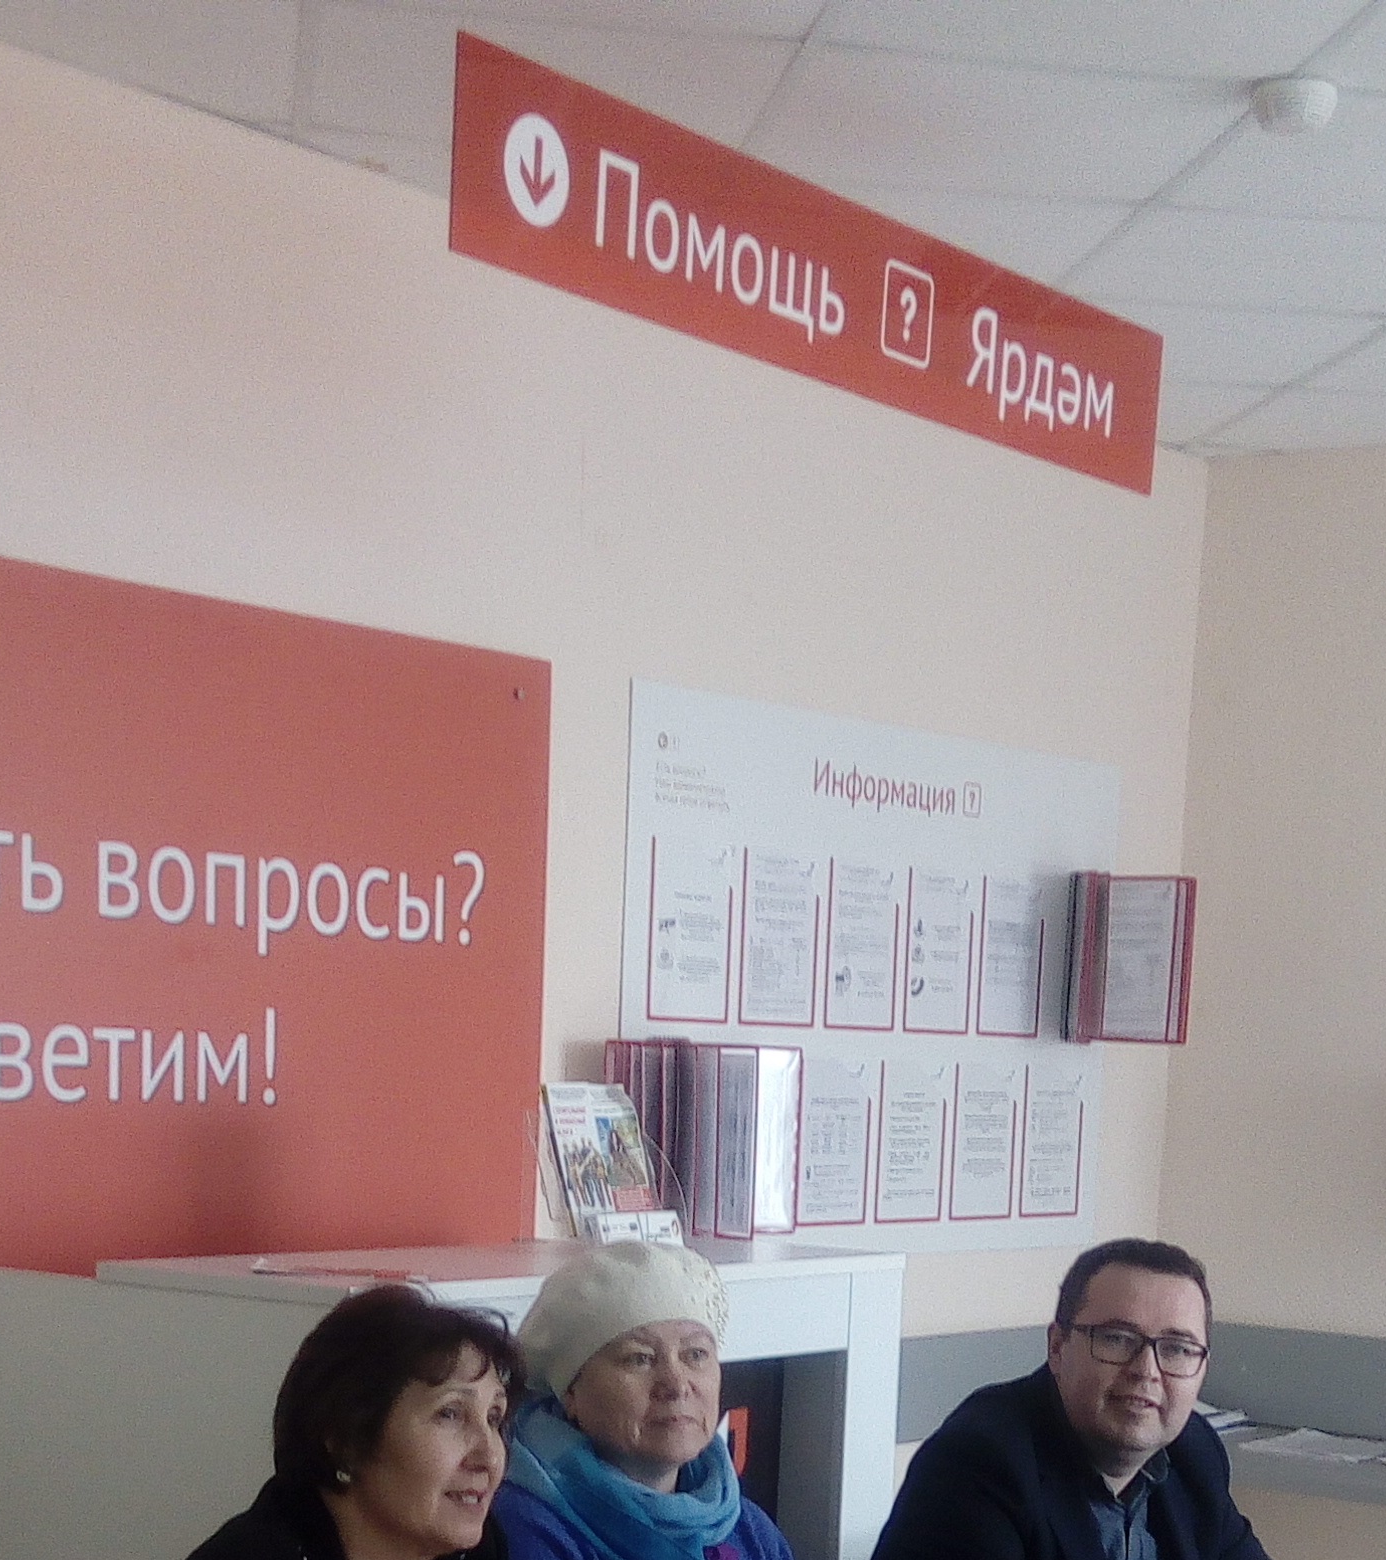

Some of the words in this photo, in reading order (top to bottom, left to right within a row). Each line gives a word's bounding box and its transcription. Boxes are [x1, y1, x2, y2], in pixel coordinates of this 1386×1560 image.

[594, 149, 844, 343] Помощь
[967, 306, 1114, 438] Ярдәм
[814, 757, 956, 817] Информация
[98, 841, 485, 954] вопросы?
